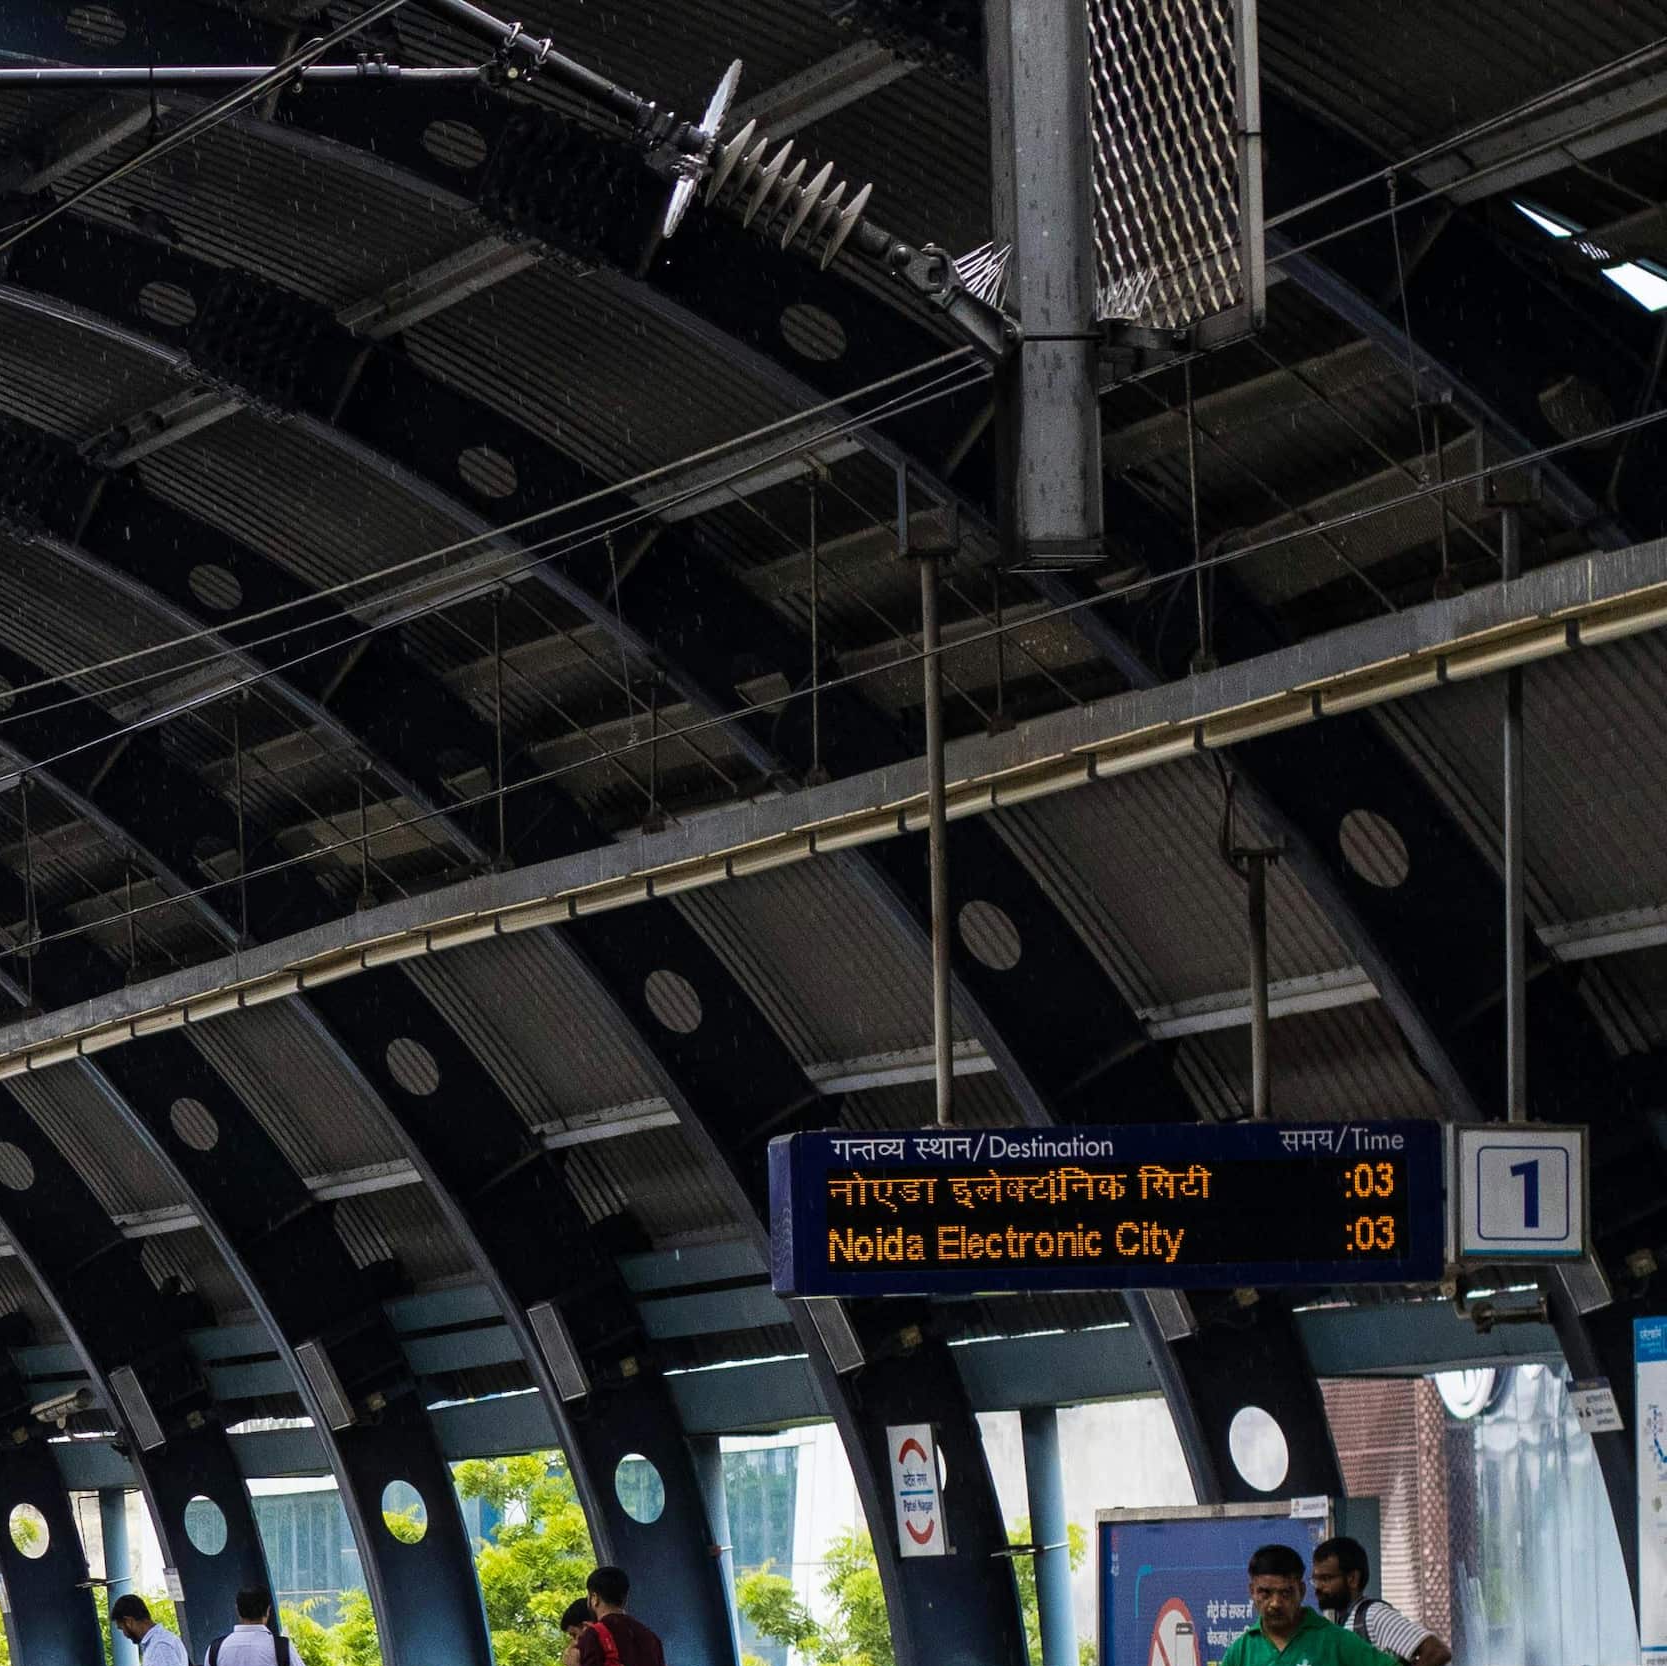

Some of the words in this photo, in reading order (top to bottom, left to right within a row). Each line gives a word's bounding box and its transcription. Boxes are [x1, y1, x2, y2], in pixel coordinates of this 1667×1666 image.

[830, 1138, 906, 1162] गन्तव्य
[828, 1171, 938, 1213] नोएडा
[1137, 1164, 1212, 1200] सिटी
[1344, 1162, 1395, 1199] :03
[1510, 1159, 1540, 1229] 1
[828, 1226, 927, 1263] Noida
[937, 1223, 1103, 1260] Electronic
[1115, 1220, 1185, 1264] City
[1345, 1215, 1396, 1251] :03
